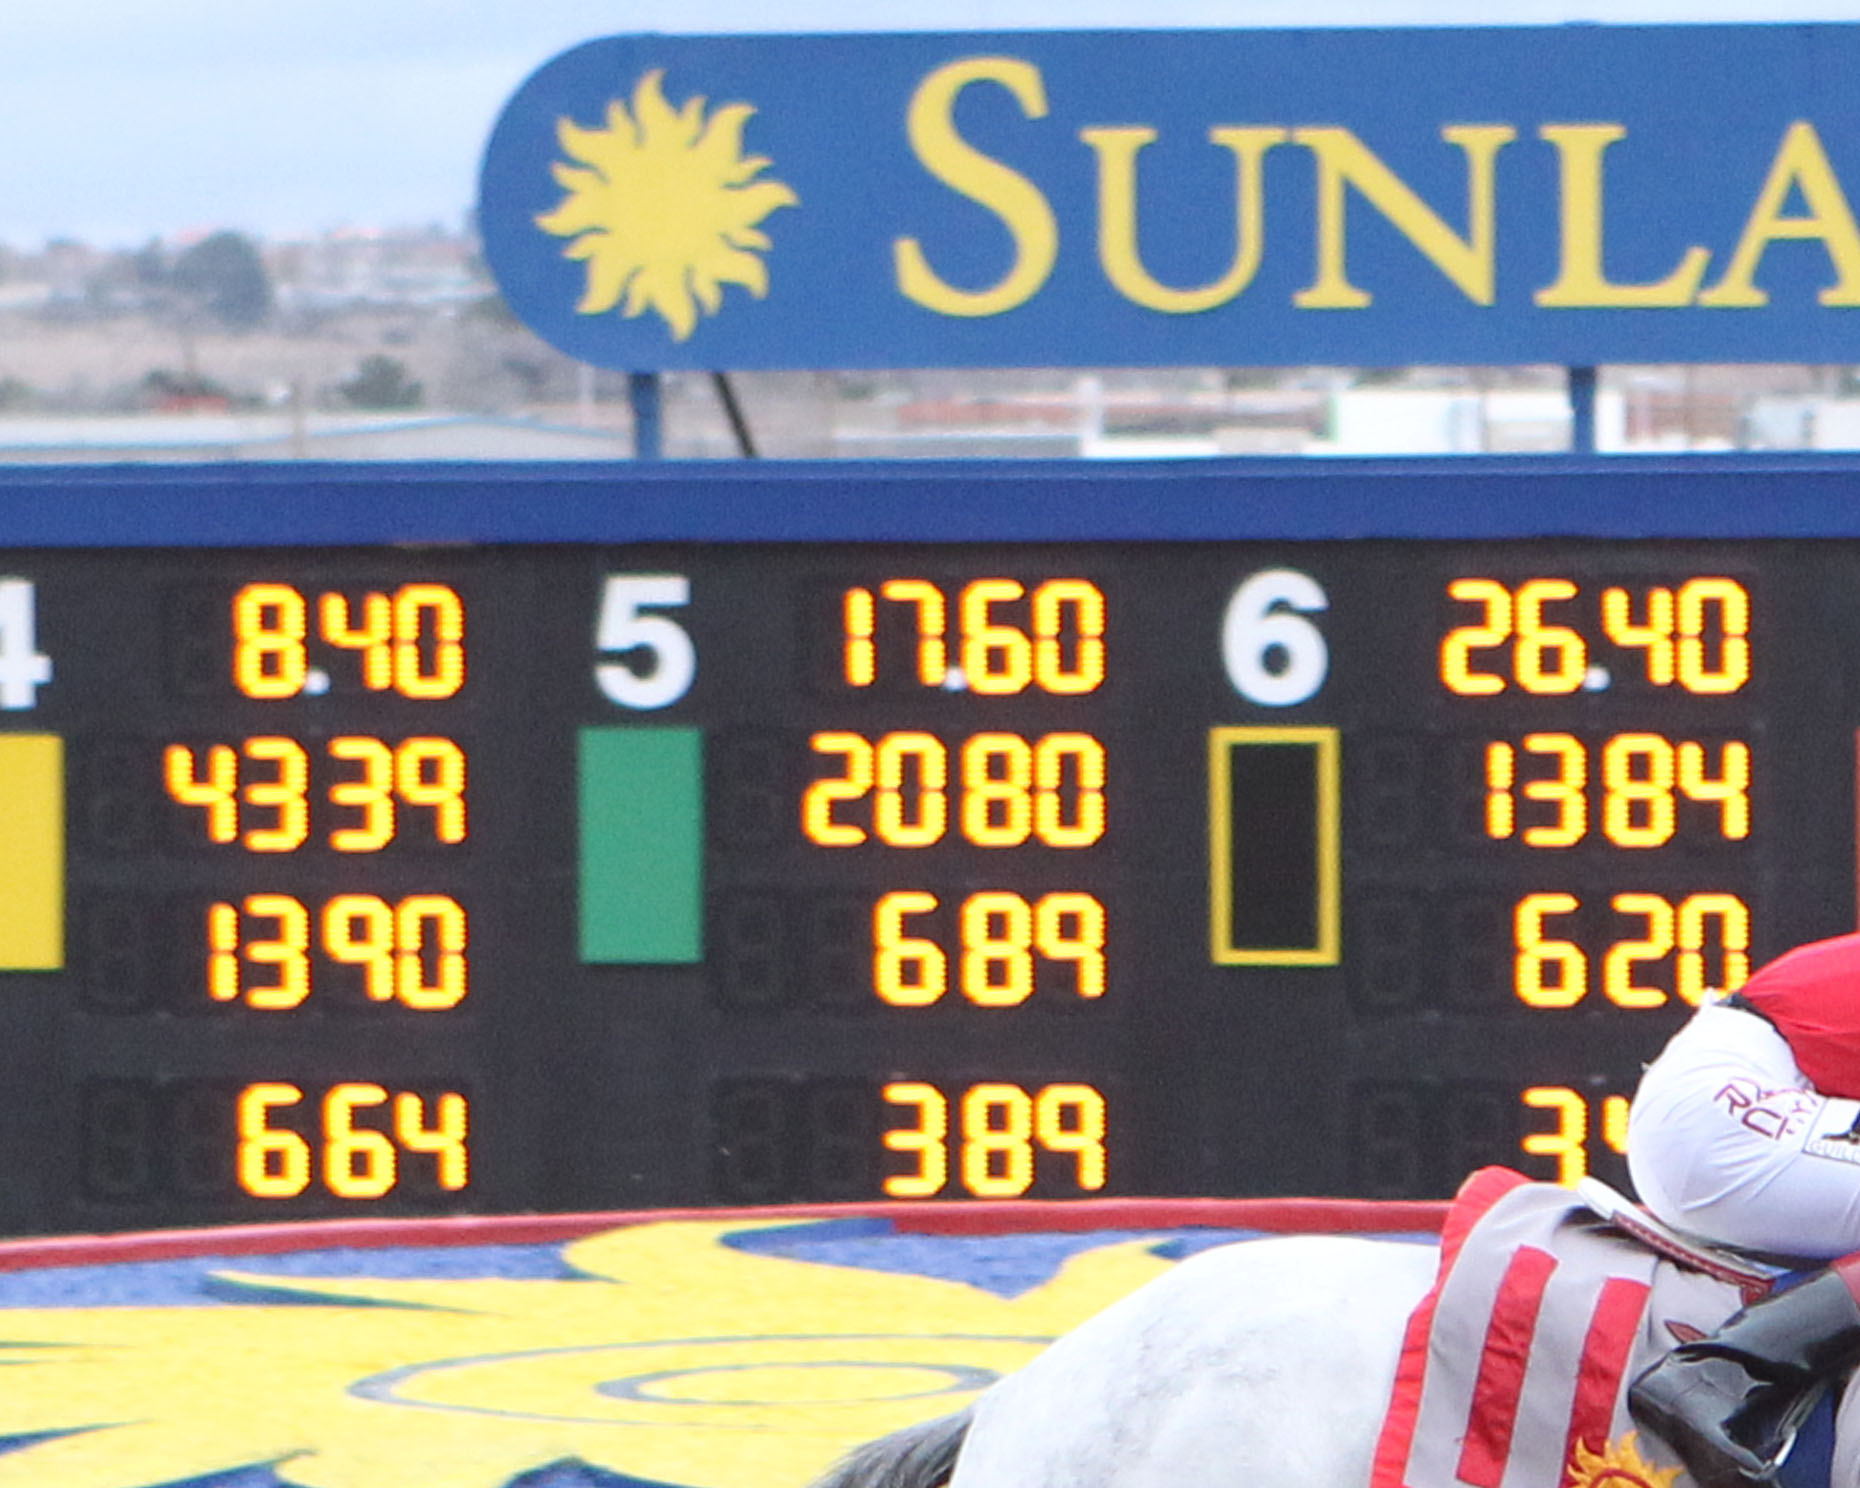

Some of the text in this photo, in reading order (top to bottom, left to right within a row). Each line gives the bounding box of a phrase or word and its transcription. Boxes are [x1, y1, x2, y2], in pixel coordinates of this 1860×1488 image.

[232, 582, 466, 699] 8.40
[594, 574, 696, 709] 5
[843, 578, 1106, 696] 17.60
[1221, 568, 1328, 707] 6
[1438, 577, 1751, 696] 26.40
[206, 892, 468, 1011] 1390
[871, 889, 1108, 1008] 689
[1512, 891, 1751, 1010] 620
[235, 1081, 469, 1199] 664
[881, 1080, 1108, 1200] 389
